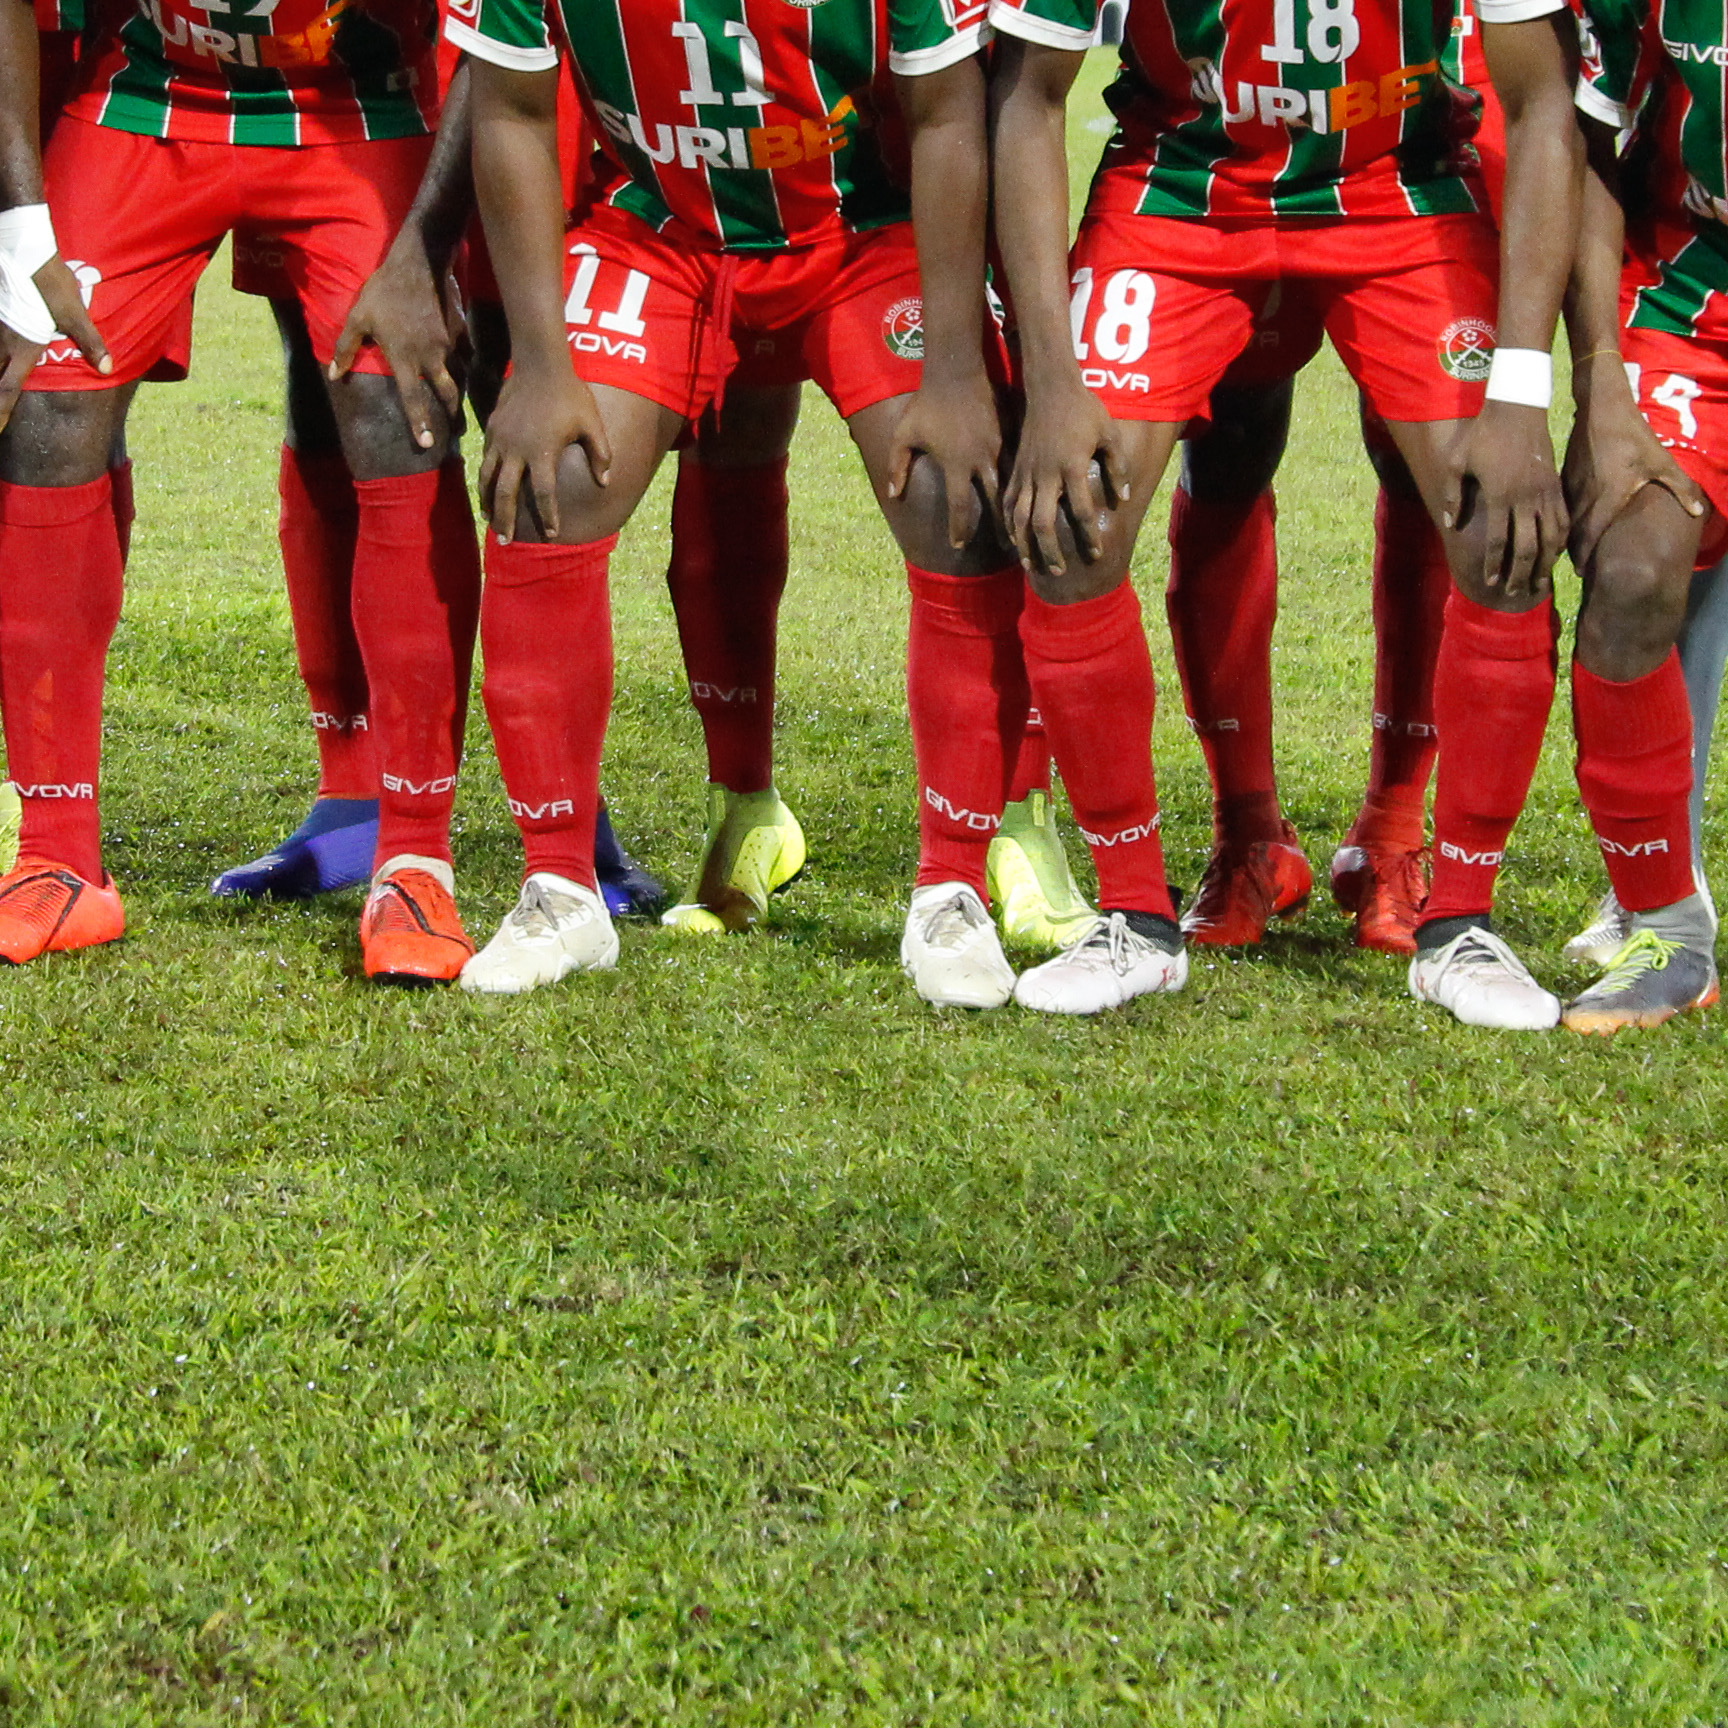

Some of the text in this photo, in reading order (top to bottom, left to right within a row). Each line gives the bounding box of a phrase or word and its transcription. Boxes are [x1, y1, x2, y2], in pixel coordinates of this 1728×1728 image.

[671, 20, 776, 107] 11
[1071, 267, 1157, 365] 18
[383, 772, 457, 795] GIVO
